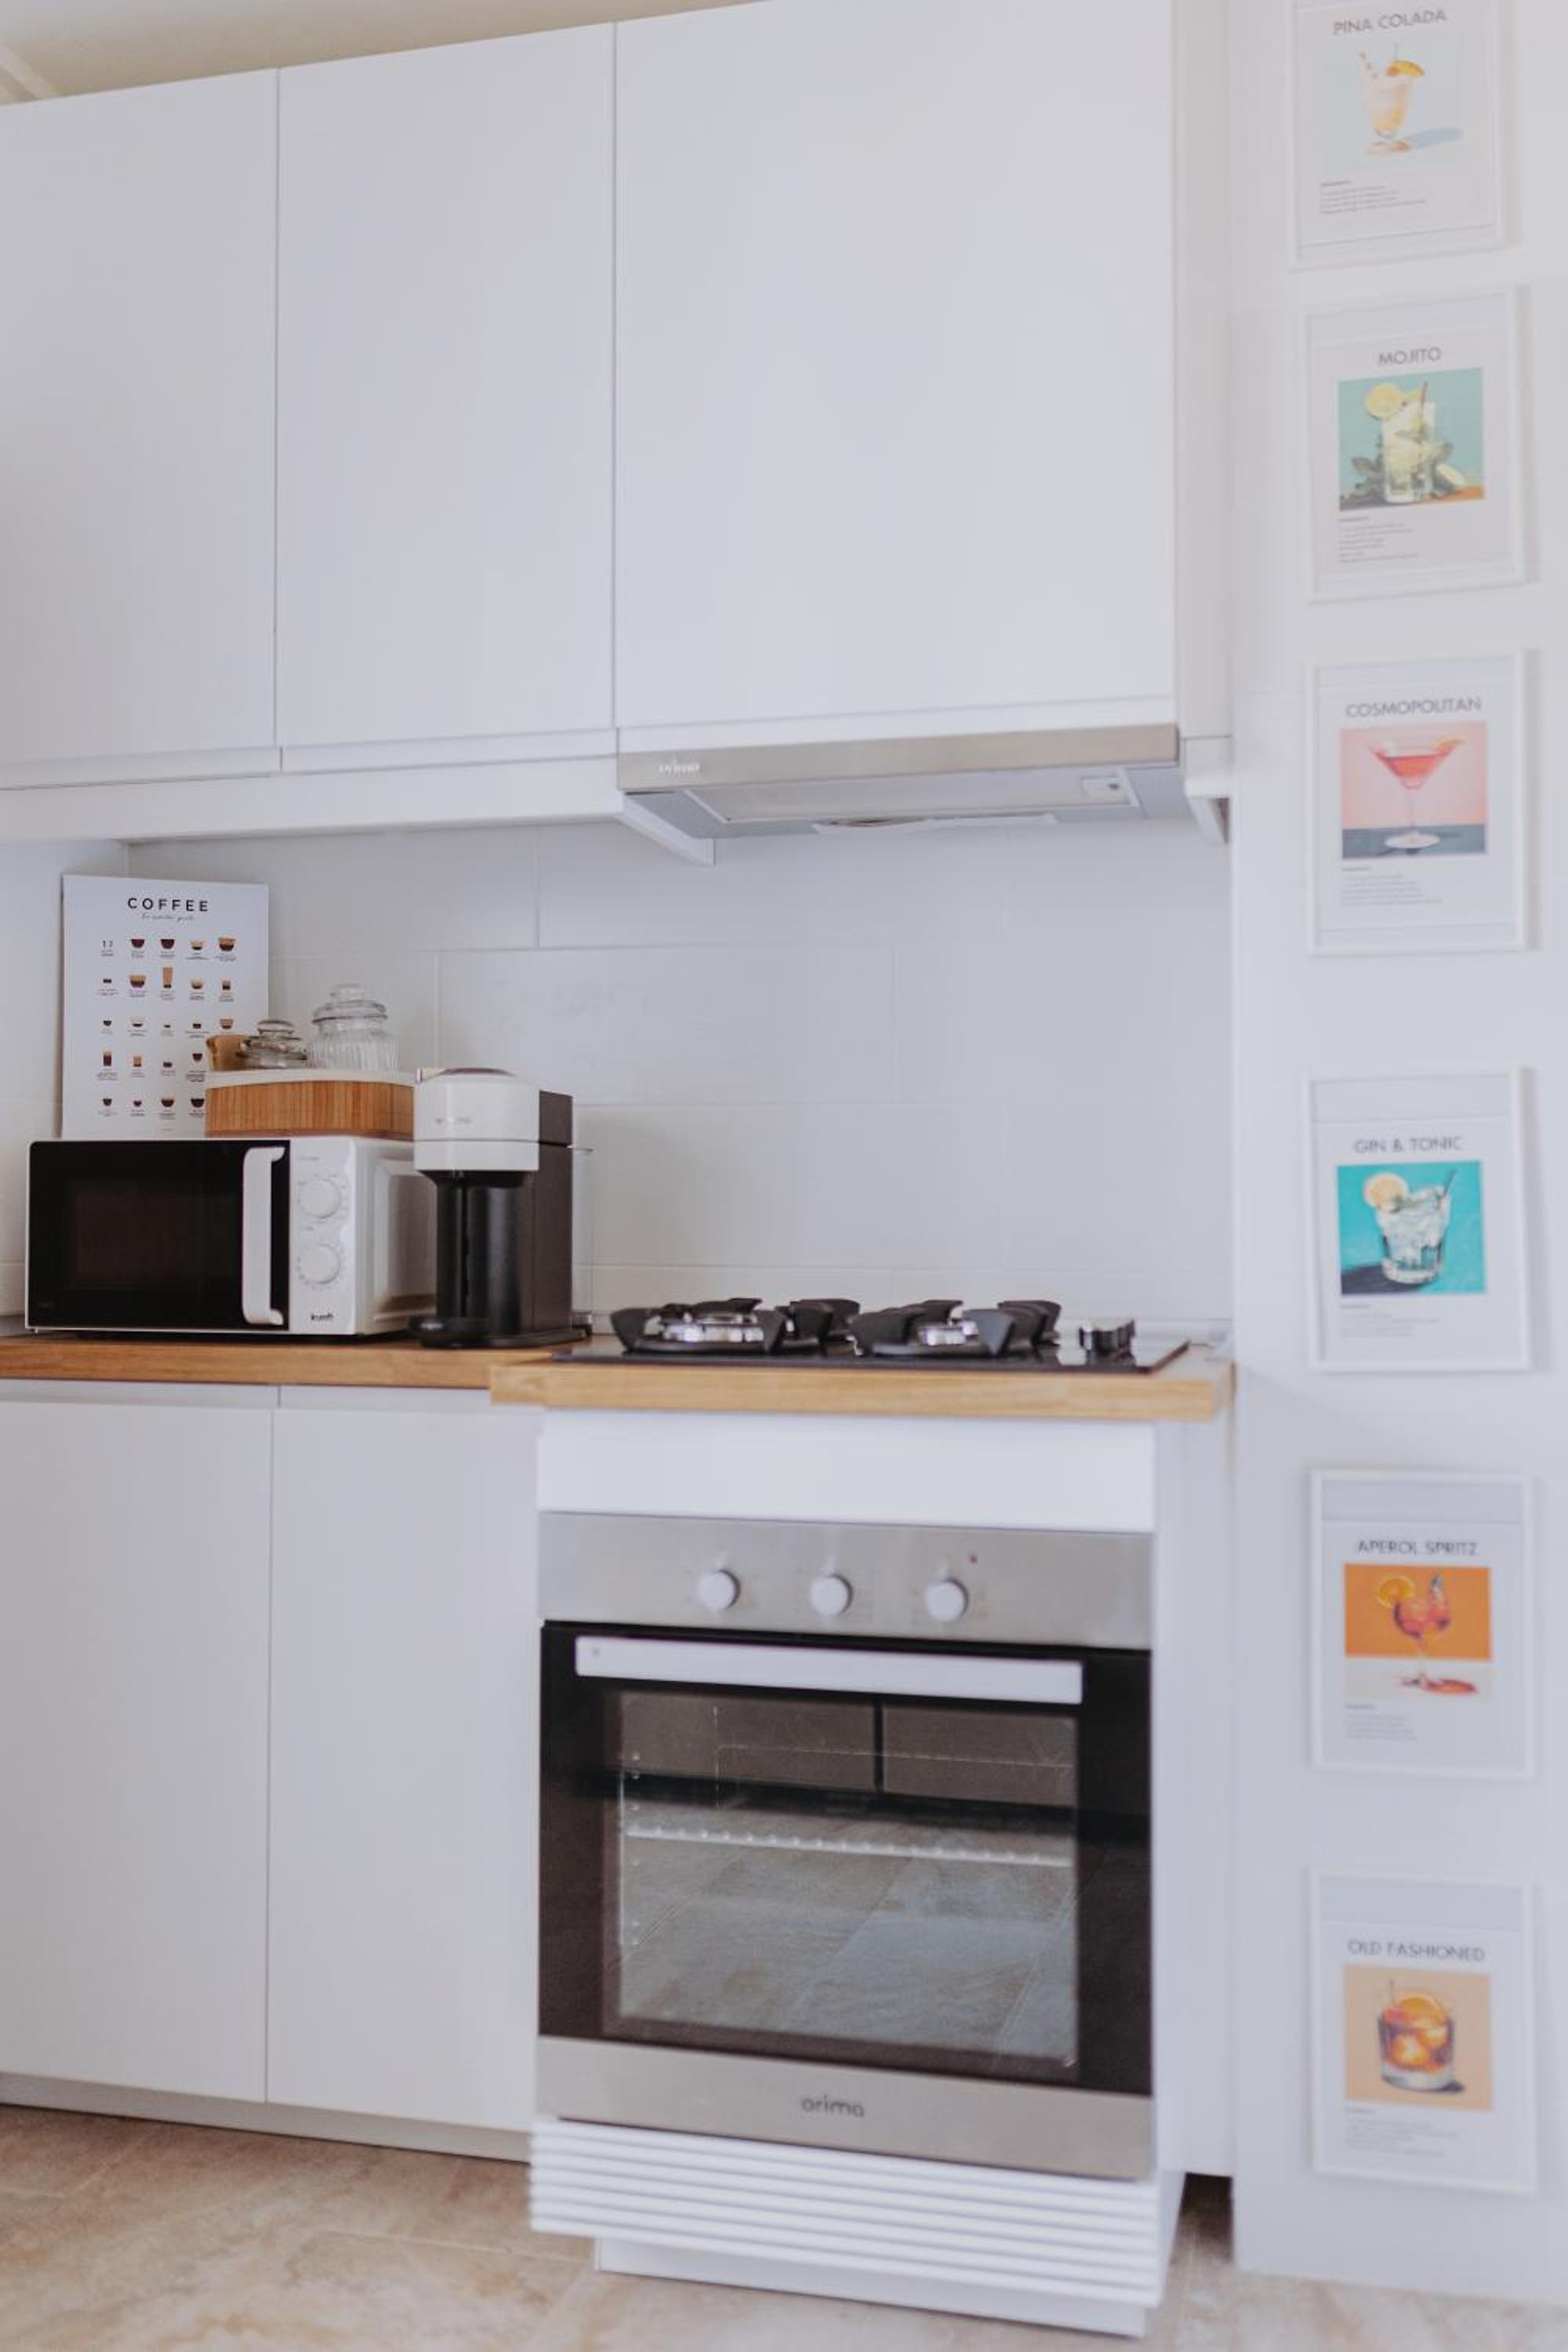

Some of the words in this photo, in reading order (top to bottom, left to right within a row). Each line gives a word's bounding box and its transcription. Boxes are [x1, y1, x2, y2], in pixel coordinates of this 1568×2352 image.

[1377, 9, 1448, 30] COLADA
[1377, 347, 1443, 366] MOJITO
[1345, 695, 1481, 718] COSMOPOLITAN
[127, 898, 209, 912] COFFEE
[1354, 1138, 1387, 1154] GIN
[1392, 1138, 1404, 1153] &
[1410, 1136, 1465, 1152] TONIC
[1357, 1540, 1417, 1556] APEROL
[1425, 1540, 1479, 1557] SPRITZ
[1347, 1938, 1382, 1957] OLD
[1387, 1941, 1486, 1962] FASHIONED
